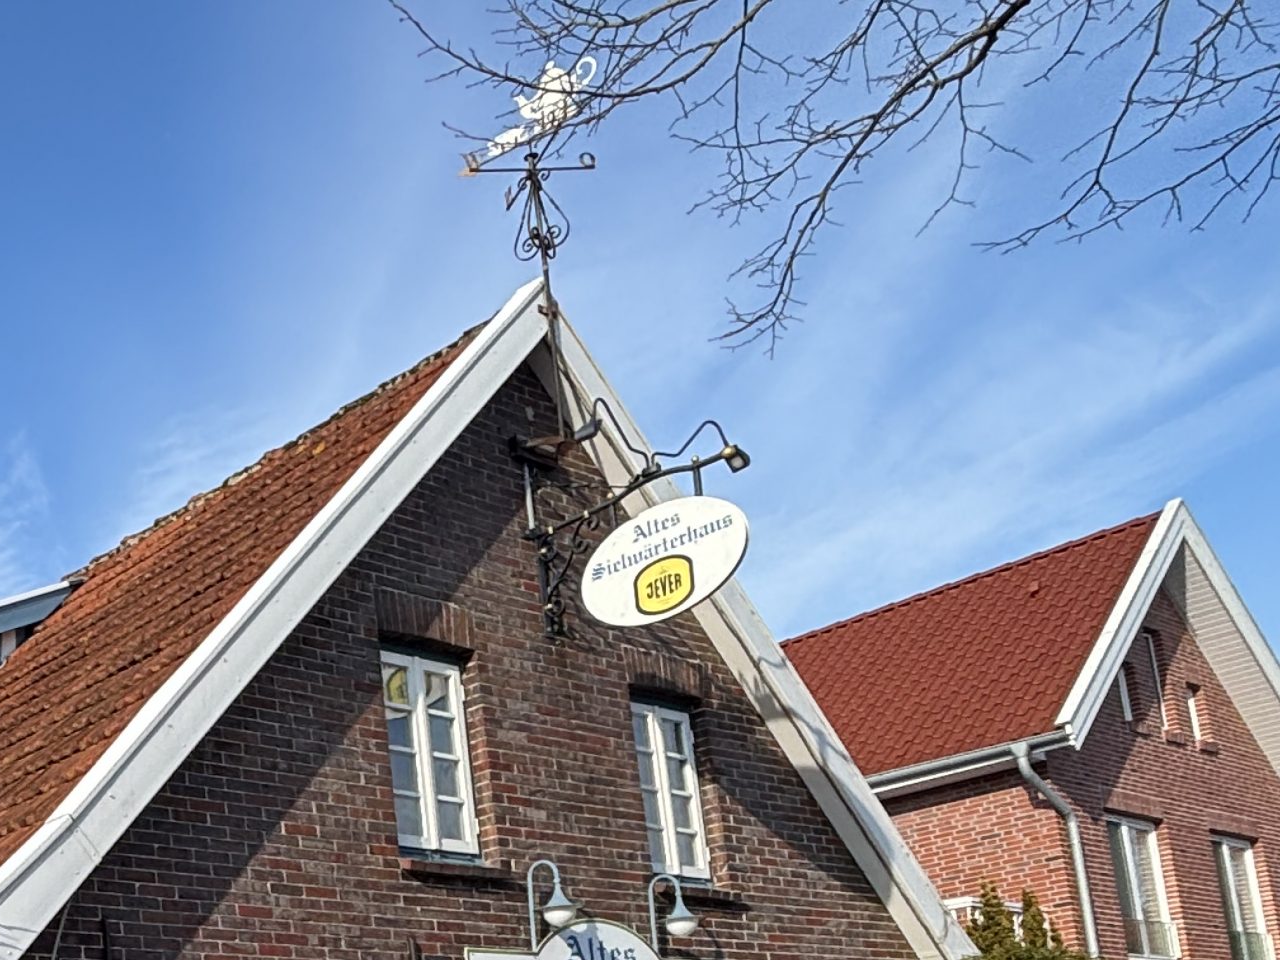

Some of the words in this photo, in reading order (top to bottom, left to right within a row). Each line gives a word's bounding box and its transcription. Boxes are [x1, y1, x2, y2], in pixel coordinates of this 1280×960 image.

[633, 514, 680, 543] Altes
[592, 515, 733, 582] Sielwärterhaus
[646, 574, 682, 599] JEVER
